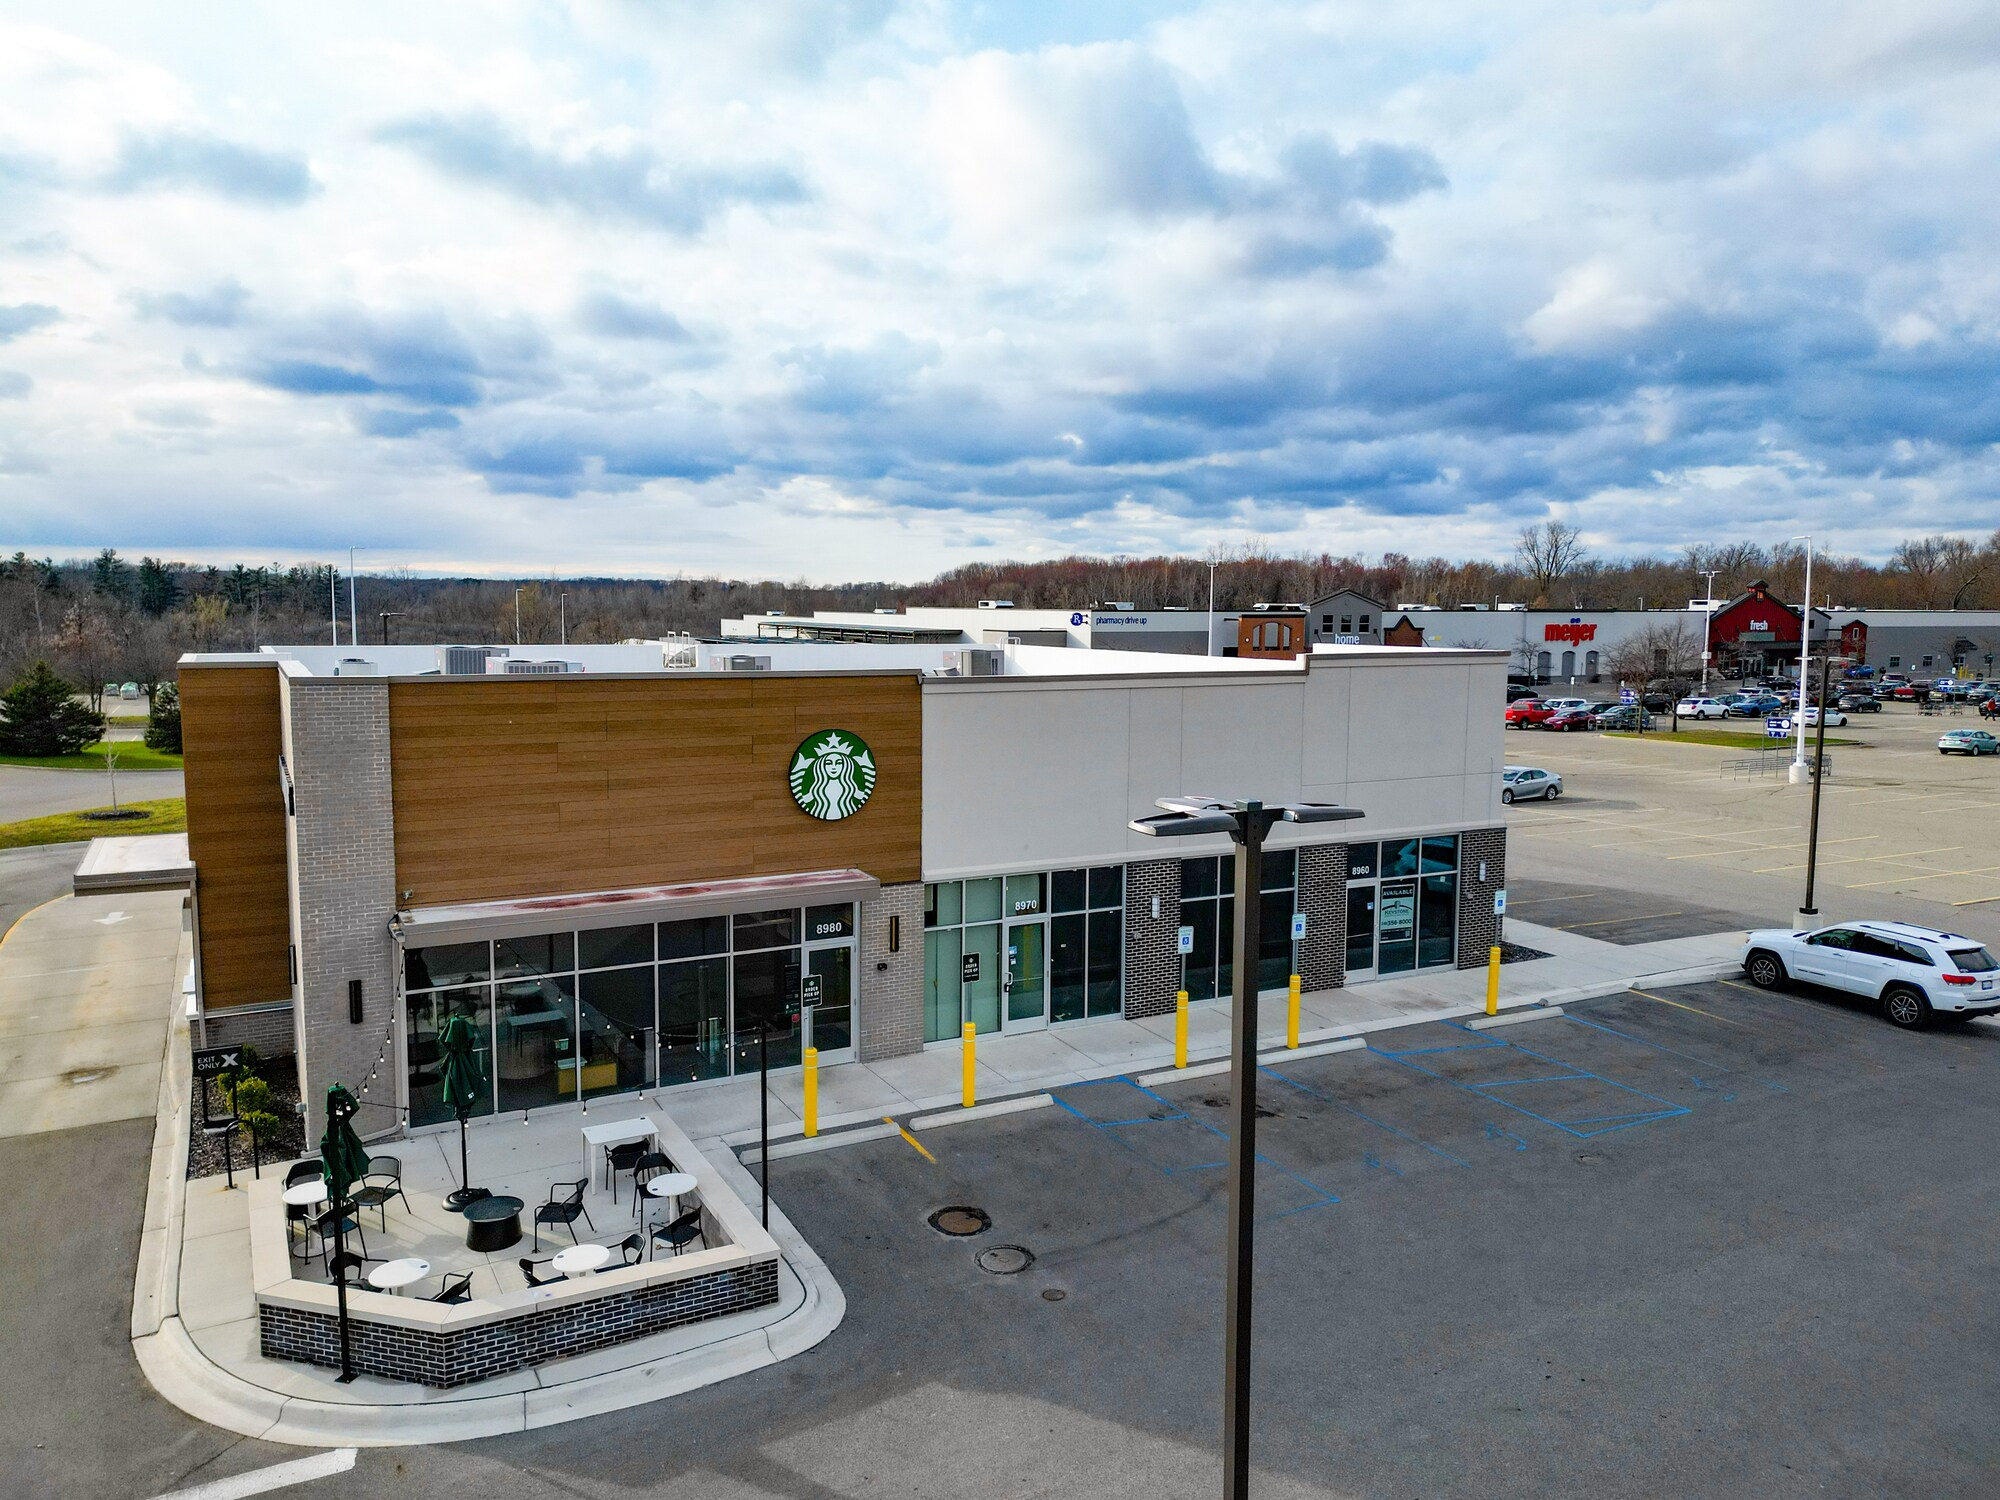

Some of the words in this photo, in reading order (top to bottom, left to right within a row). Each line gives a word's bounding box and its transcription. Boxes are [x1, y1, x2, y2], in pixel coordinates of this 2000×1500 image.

[1095, 616, 1124, 626] pharmacy
[1124, 616, 1139, 625] drive
[1139, 617, 1148, 626] up
[1749, 619, 1769, 631] fresh
[1544, 617, 1598, 647] meijer
[1334, 633, 1360, 645] home
[1351, 865, 1370, 875] 8960
[1383, 888, 1414, 896] AVAILABLE
[1014, 899, 1037, 911] 8970
[816, 921, 842, 935] 8980
[197, 1055, 216, 1064] EXIT
[197, 1061, 220, 1071] ONLY
